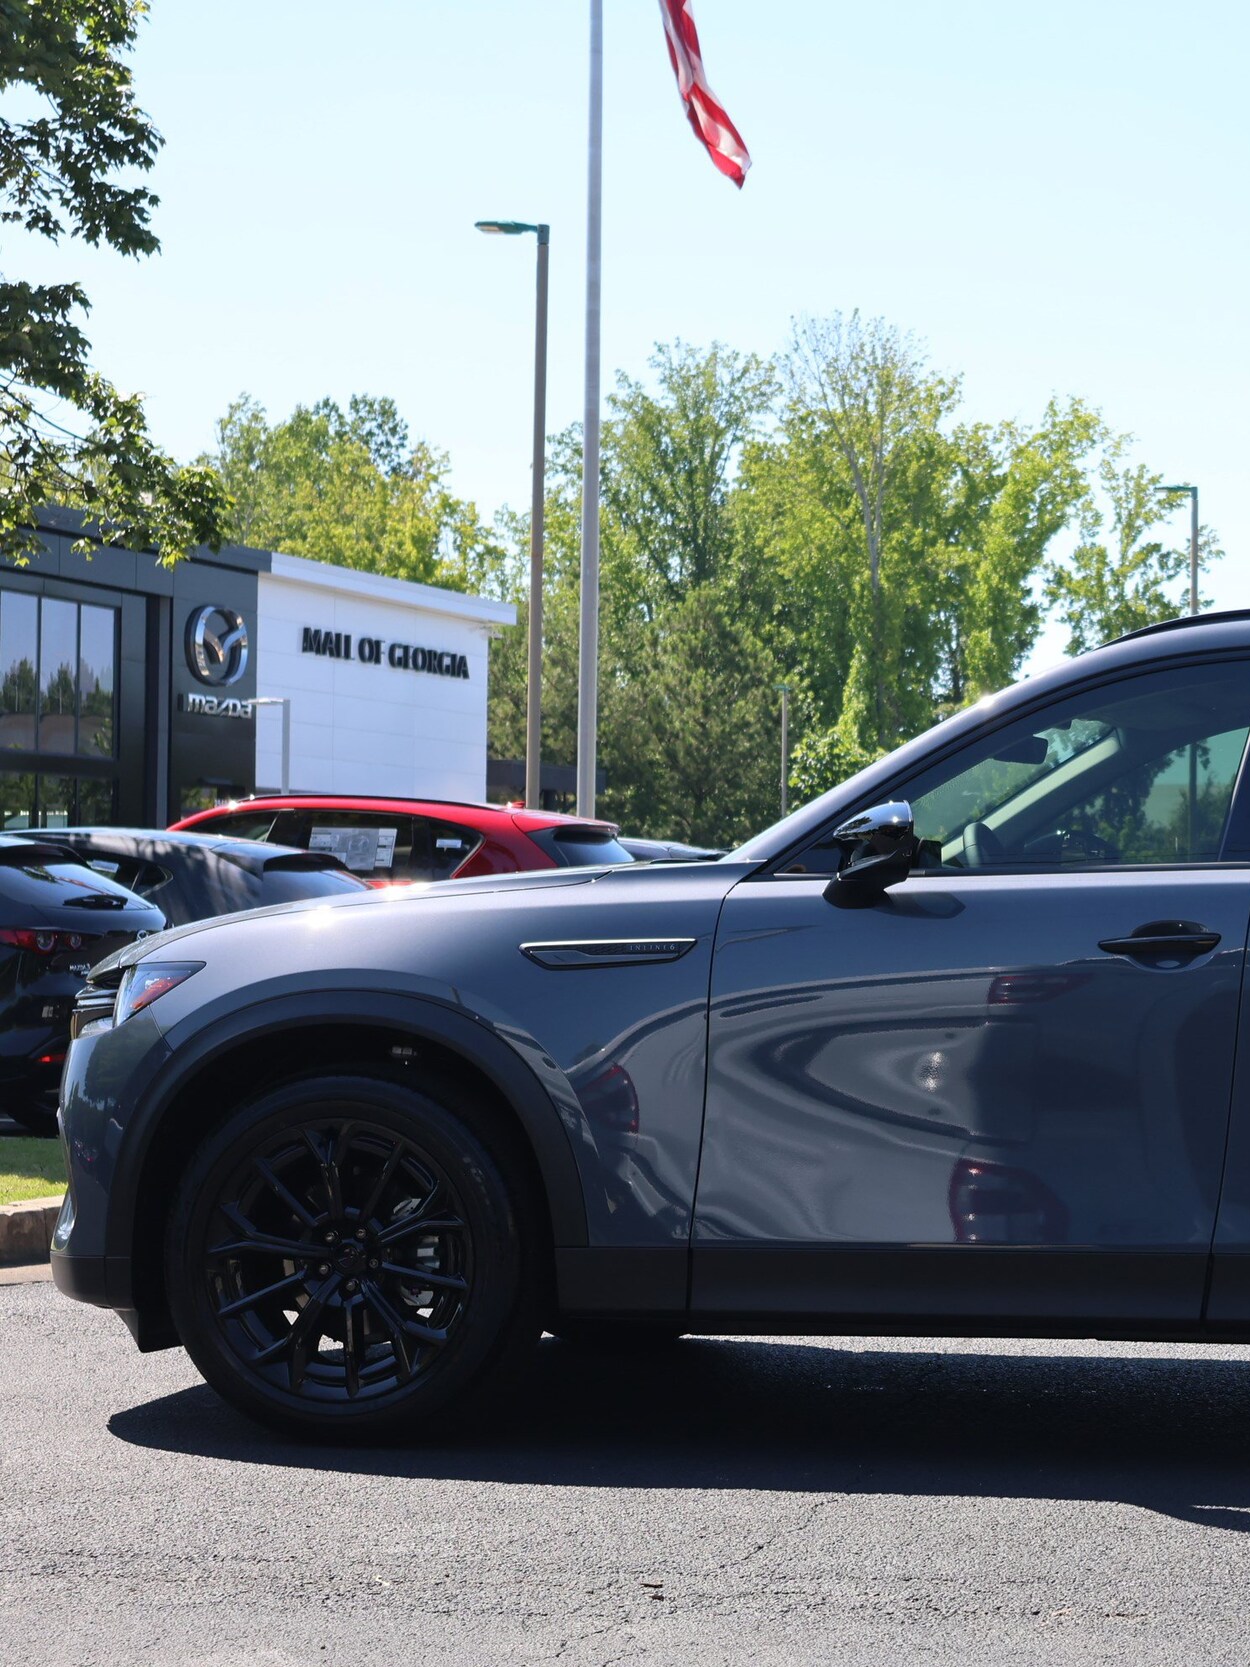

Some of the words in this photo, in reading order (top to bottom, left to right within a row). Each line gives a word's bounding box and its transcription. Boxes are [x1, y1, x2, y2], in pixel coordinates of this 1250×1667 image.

[302, 627, 354, 660] MALL
[358, 637, 384, 664] OF
[388, 643, 470, 679] GEORGIA
